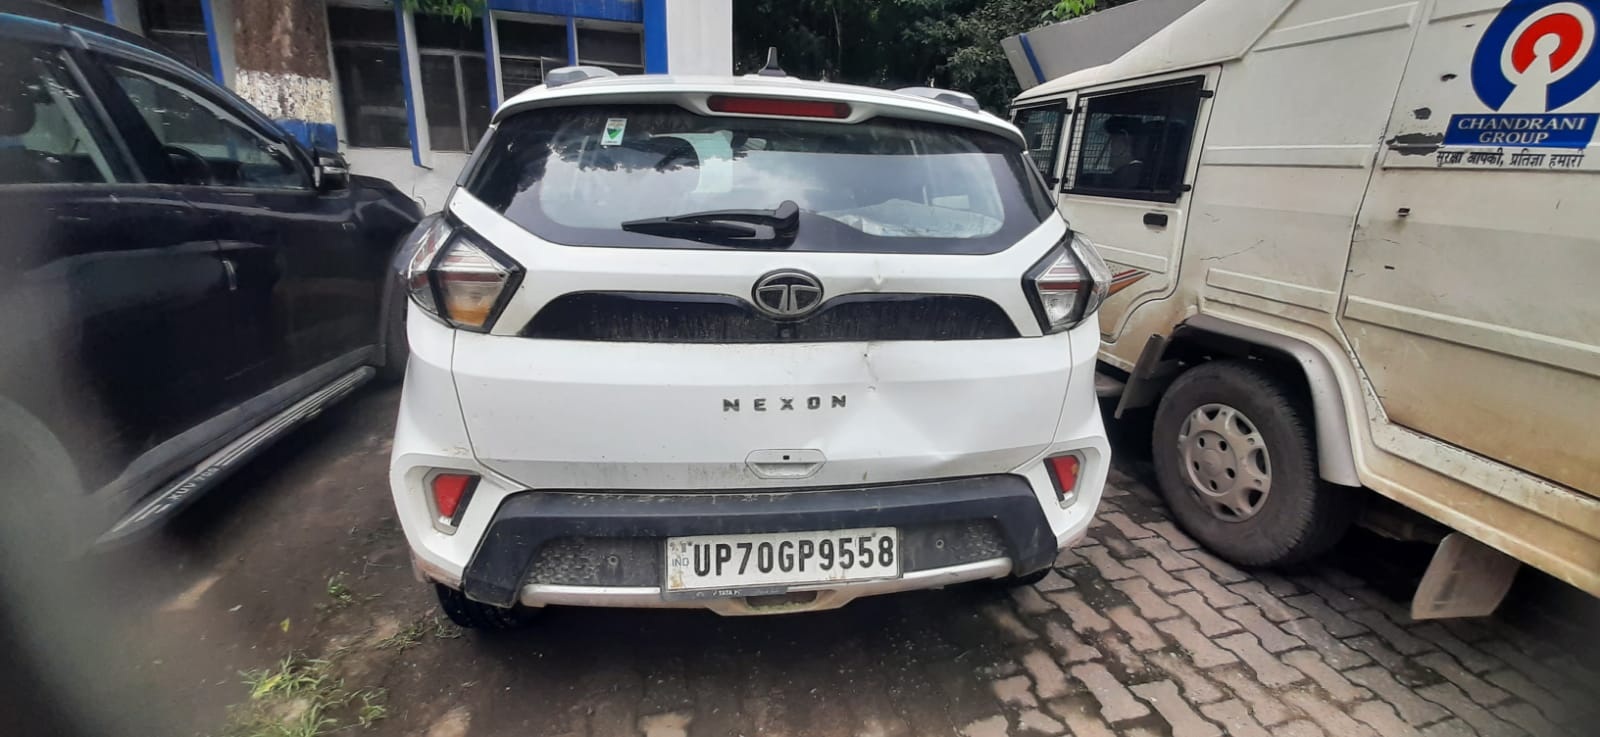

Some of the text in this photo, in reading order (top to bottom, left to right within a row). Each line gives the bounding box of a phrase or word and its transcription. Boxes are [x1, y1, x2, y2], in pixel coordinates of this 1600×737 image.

[1458, 117, 1587, 130] CHANDRANI
[1479, 131, 1549, 144] GROUP
[1436, 151, 1464, 167] सुरक्षा
[1509, 148, 1546, 167] प्रतिज्ञा
[722, 395, 847, 412] NEXON
[671, 557, 690, 567] IND
[694, 536, 894, 577] UP70GP9558
